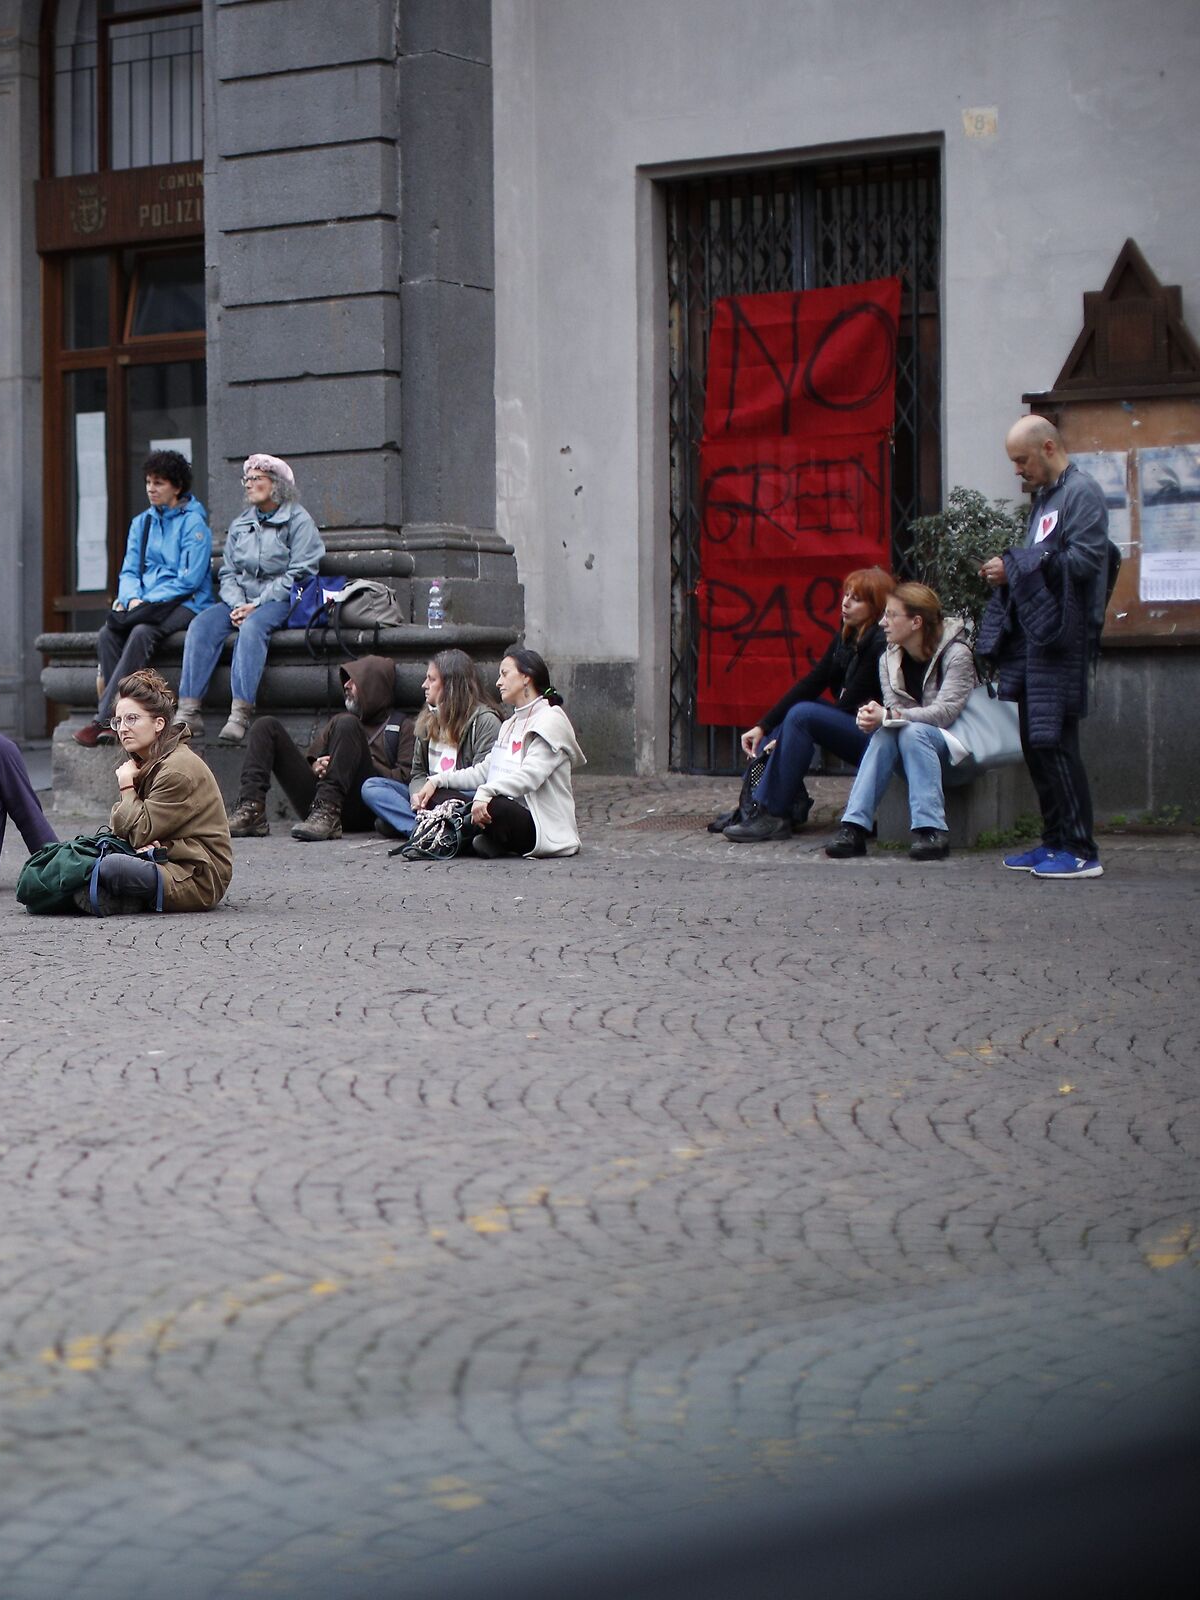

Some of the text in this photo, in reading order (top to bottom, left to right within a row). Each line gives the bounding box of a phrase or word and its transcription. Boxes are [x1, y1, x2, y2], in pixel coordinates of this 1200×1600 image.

[138, 198, 202, 228] POLIZI
[160, 172, 204, 190] COMUN
[725, 297, 898, 436] NO
[702, 439, 887, 547] GREEN
[698, 576, 842, 688] PAS
